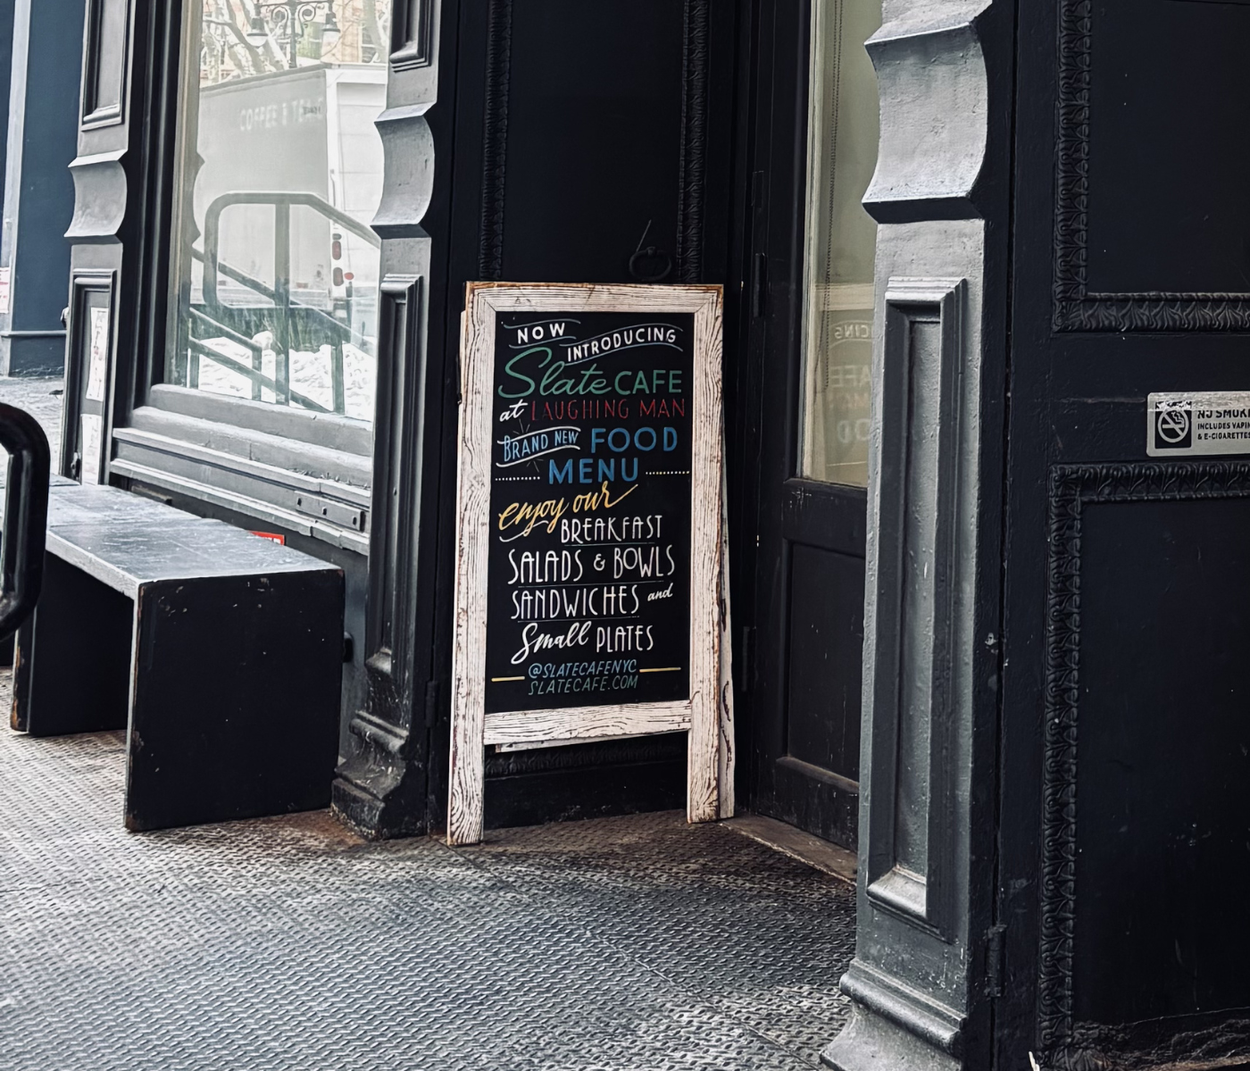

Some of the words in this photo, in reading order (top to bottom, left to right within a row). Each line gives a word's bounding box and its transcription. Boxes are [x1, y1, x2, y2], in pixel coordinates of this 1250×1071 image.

[517, 323, 565, 344] NOW
[567, 327, 676, 362] INTRODUCING
[498, 347, 612, 398] Slate
[614, 370, 682, 395] CAFE
[499, 399, 528, 422] at
[531, 399, 629, 421] LAUGHING
[639, 399, 685, 418] MAN
[1197, 409, 1213, 419] NO
[1197, 422, 1231, 430] INCLUDES
[503, 434, 549, 462] BRAND
[554, 429, 579, 448] NEW
[590, 427, 678, 453] FOOD
[548, 457, 639, 484] MENU
[498, 497, 569, 537] enjoy
[573, 481, 638, 512] our
[561, 515, 662, 543] BREAKFAST
[508, 549, 583, 584] SALADS
[593, 554, 606, 571] &
[613, 544, 675, 578] BOWLS
[511, 584, 640, 620] SANDWICHES
[648, 583, 673, 602] and
[511, 621, 592, 664] Small
[596, 625, 654, 652] PLATES
[528, 659, 637, 678] @SLATECAFENYC
[528, 675, 638, 695] SLATECAFE.COM
